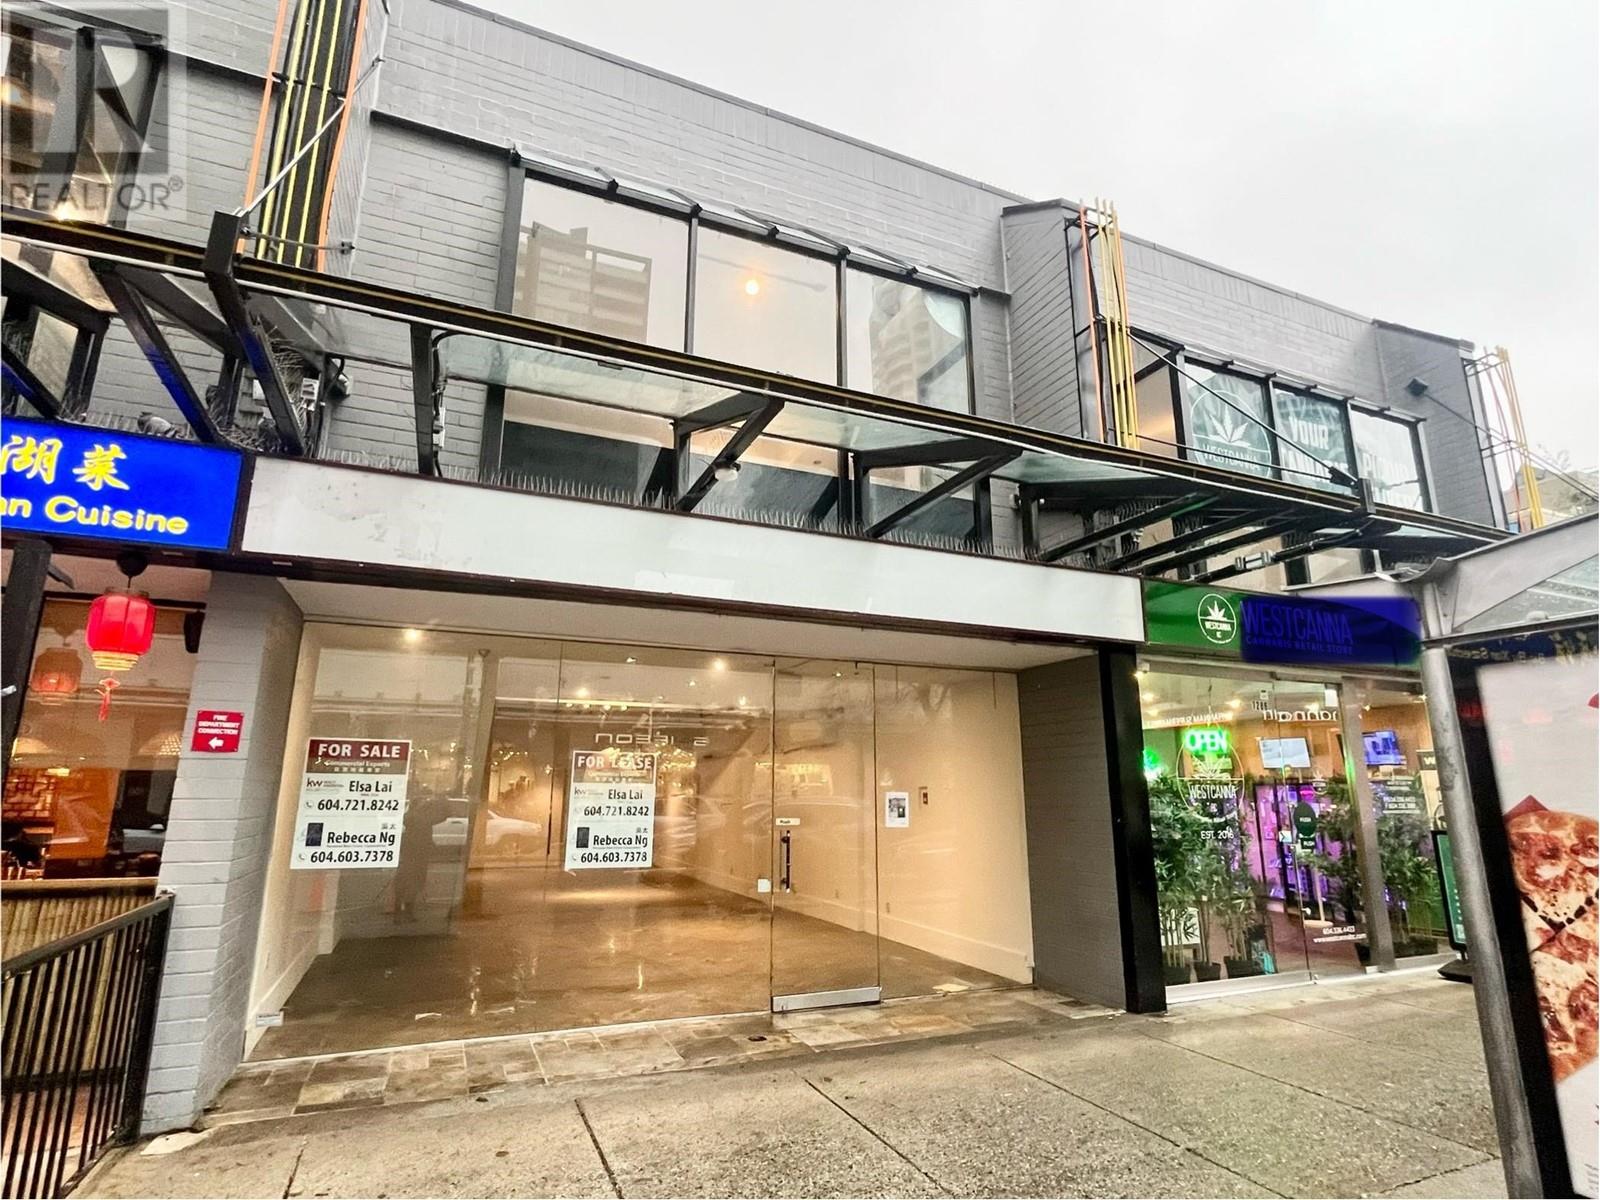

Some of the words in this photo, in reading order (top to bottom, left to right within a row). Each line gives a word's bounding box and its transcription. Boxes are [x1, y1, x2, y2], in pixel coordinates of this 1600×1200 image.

[1289, 417, 1330, 450] YOUR
[45, 495, 189, 535] Cuisine
[1240, 600, 1353, 646] WESTCANNA
[1184, 729, 1228, 752] OPEN
[318, 743, 352, 757] FOR
[360, 744, 401, 758] SALE
[577, 755, 605, 768] FOR
[612, 756, 653, 771] LEASE
[349, 780, 372, 793] Elsa
[375, 780, 393, 793] Lai
[608, 788, 627, 800] Elsa
[629, 788, 643, 800] Lai
[1189, 783, 1238, 800] WESTCANNA
[317, 799, 400, 811] 604.721.8242
[583, 805, 650, 816] 604.721.8242
[326, 831, 377, 844] Rebecca
[379, 831, 396, 847] Ng
[593, 834, 633, 846] Rebecca
[635, 834, 649, 848] Ng
[310, 850, 394, 863] 604.603.7378
[580, 851, 648, 863] 604.603.7378
